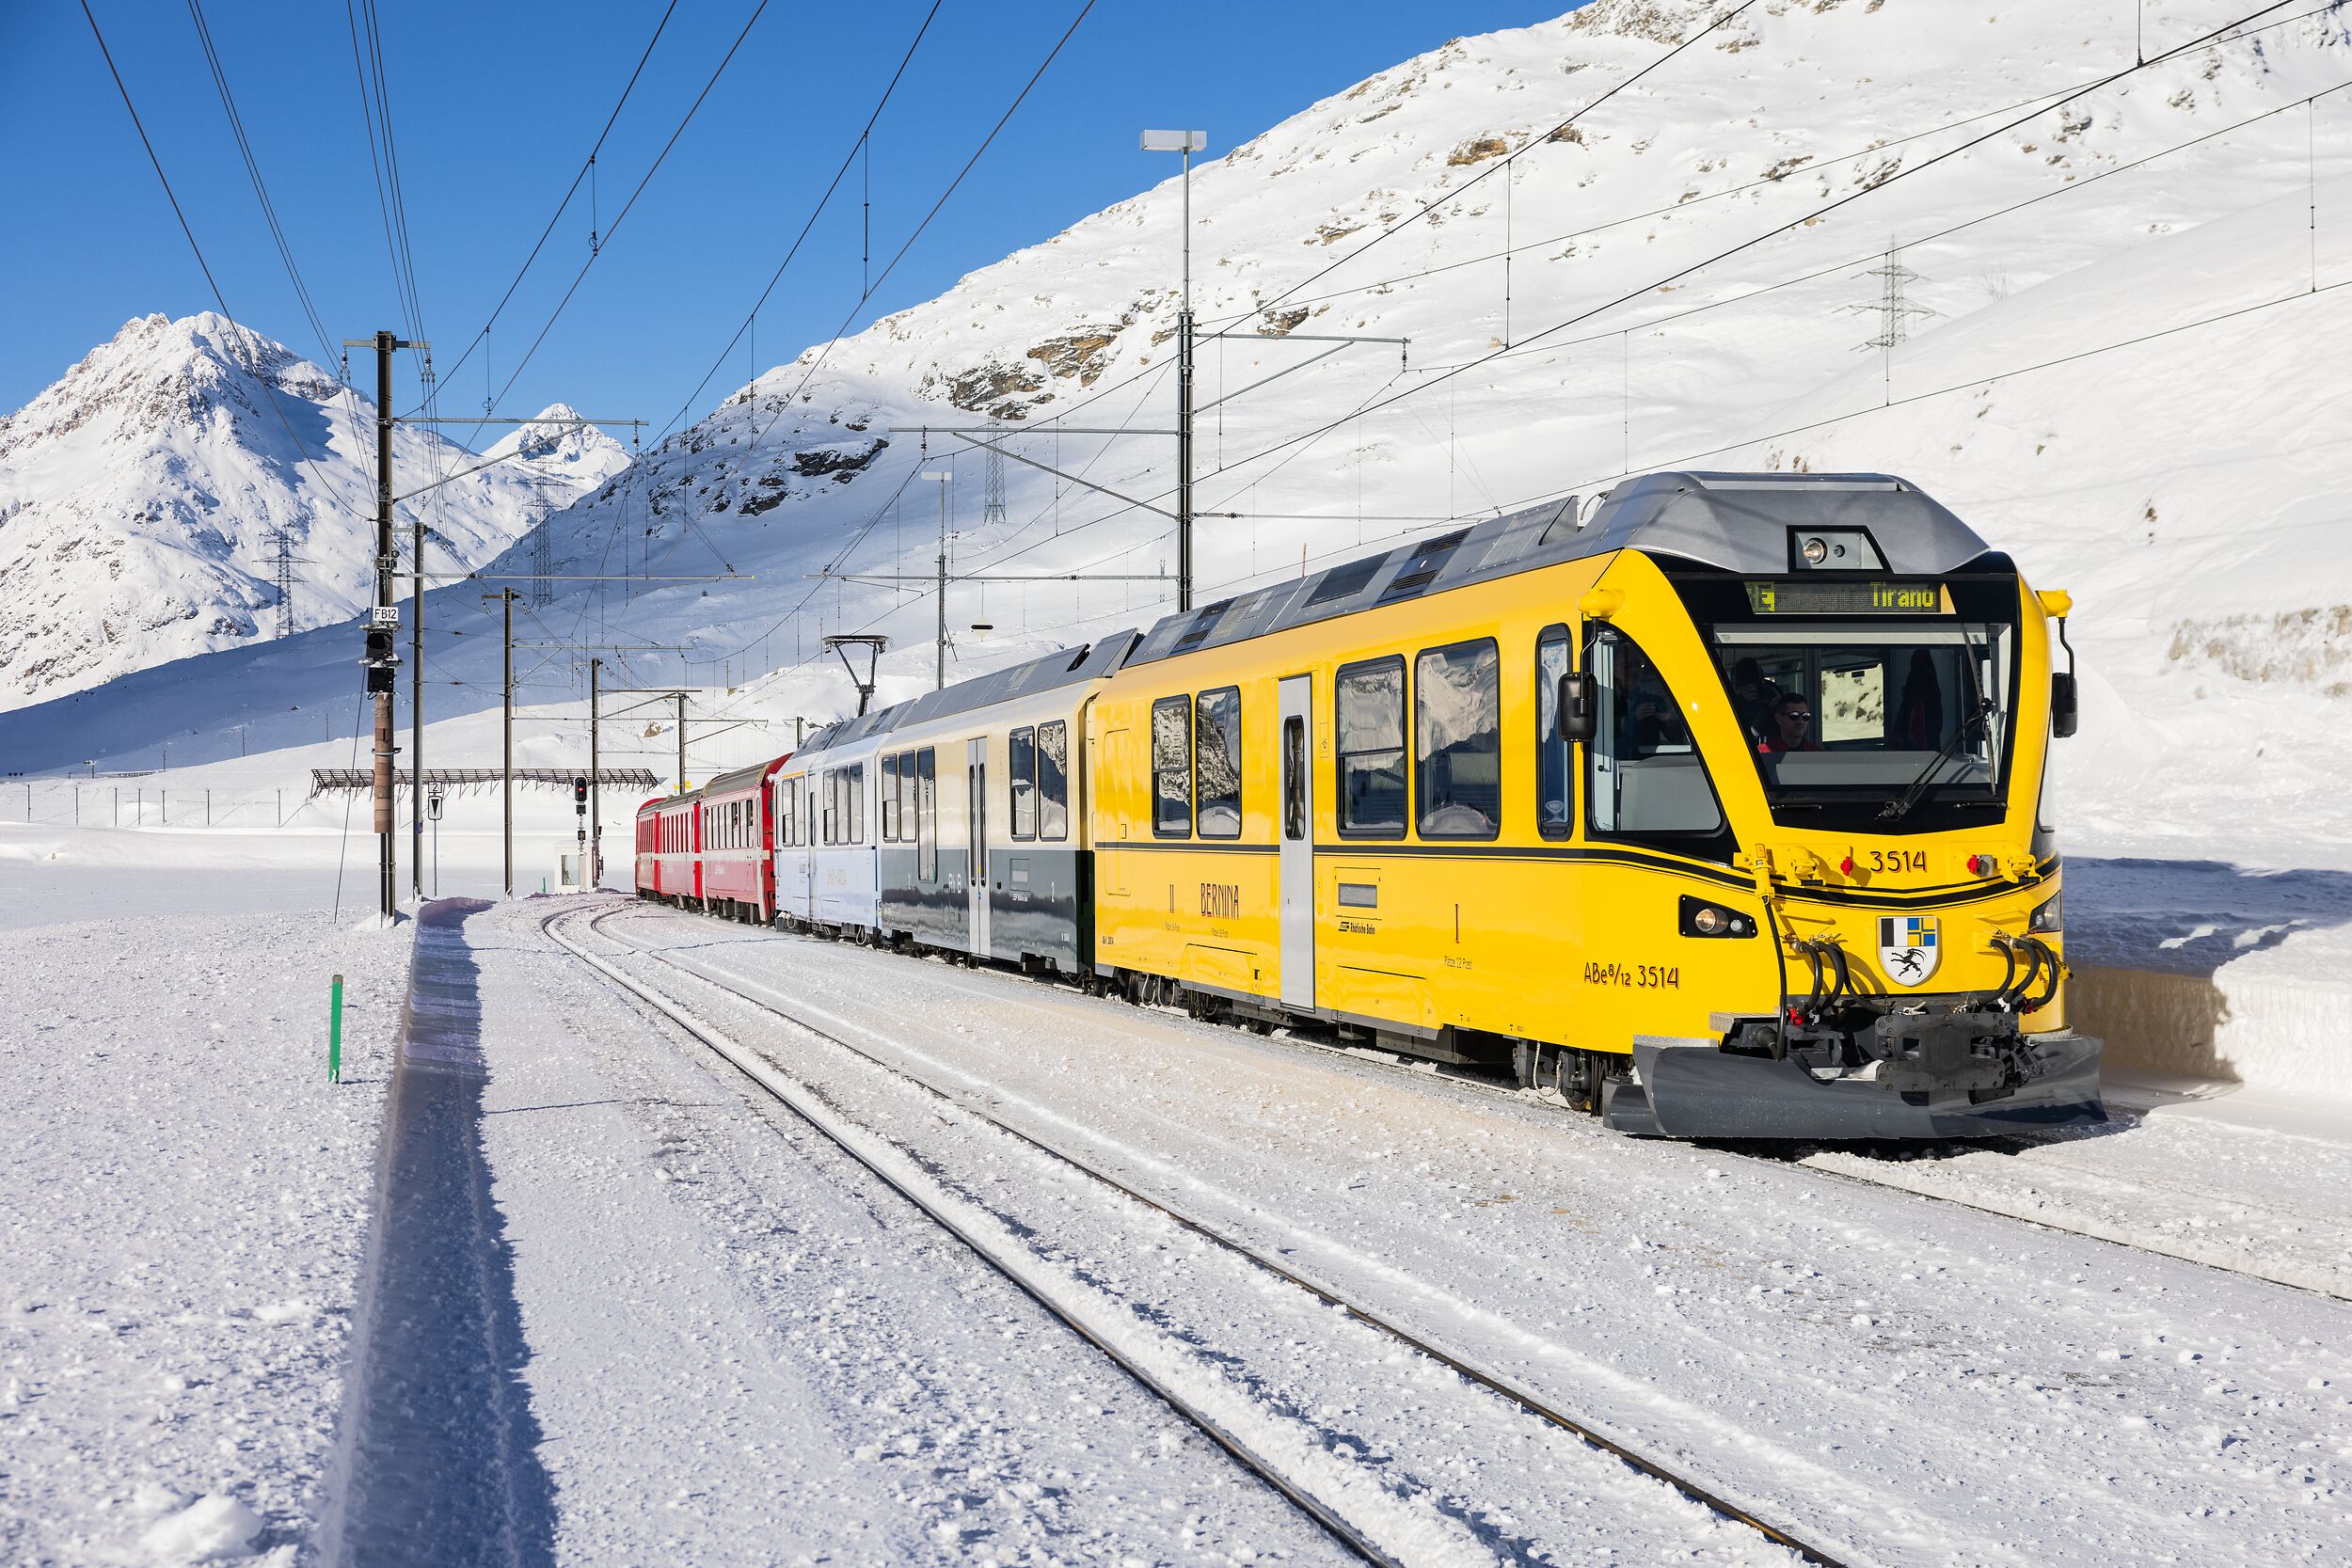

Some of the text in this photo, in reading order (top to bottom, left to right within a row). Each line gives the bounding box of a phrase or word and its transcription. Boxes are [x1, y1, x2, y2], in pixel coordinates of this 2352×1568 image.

[1870, 581, 1934, 608] Tirano
[374, 609, 397, 619] FB12
[432, 783, 438, 792] 2
[1869, 850, 1928, 873] 3514
[1200, 882, 1240, 921] BERNINA
[1637, 964, 1679, 990] 3514
